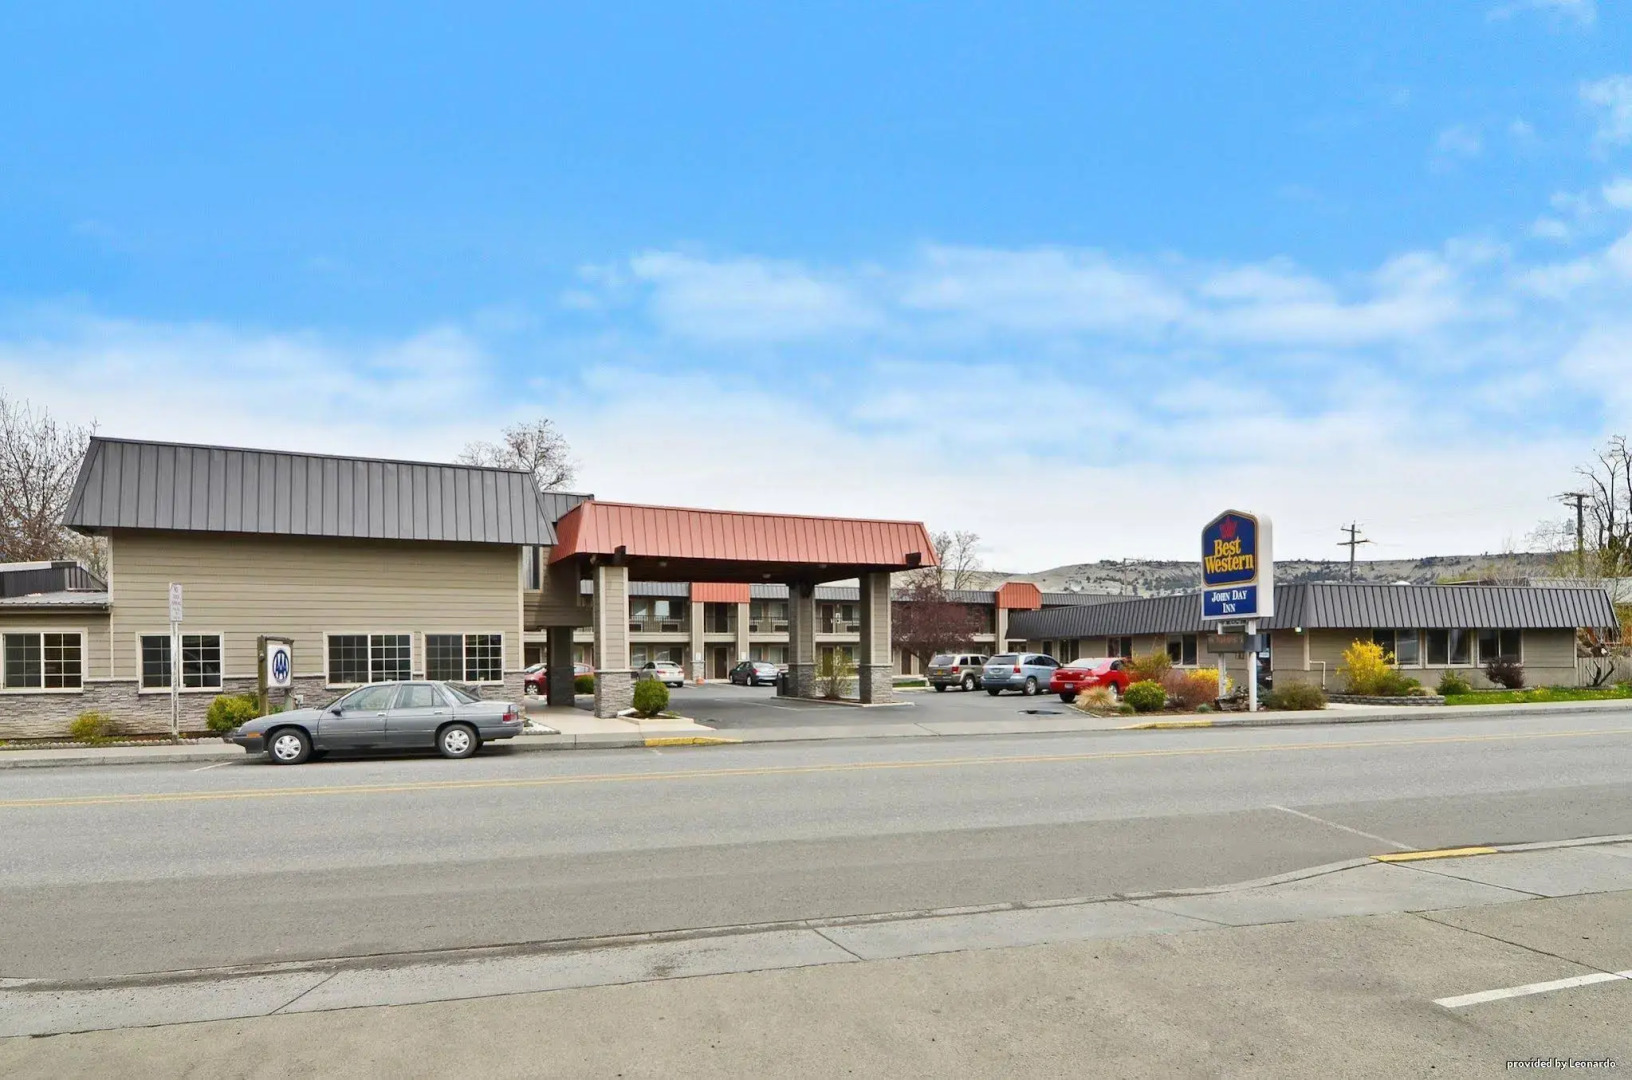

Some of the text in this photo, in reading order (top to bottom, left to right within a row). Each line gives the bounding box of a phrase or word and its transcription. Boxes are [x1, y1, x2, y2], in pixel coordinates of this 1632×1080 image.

[1214, 536, 1241, 556] Best
[1205, 554, 1254, 574] Western
[1212, 590, 1247, 602] JOHN DAY
[1223, 603, 1236, 613] INN
